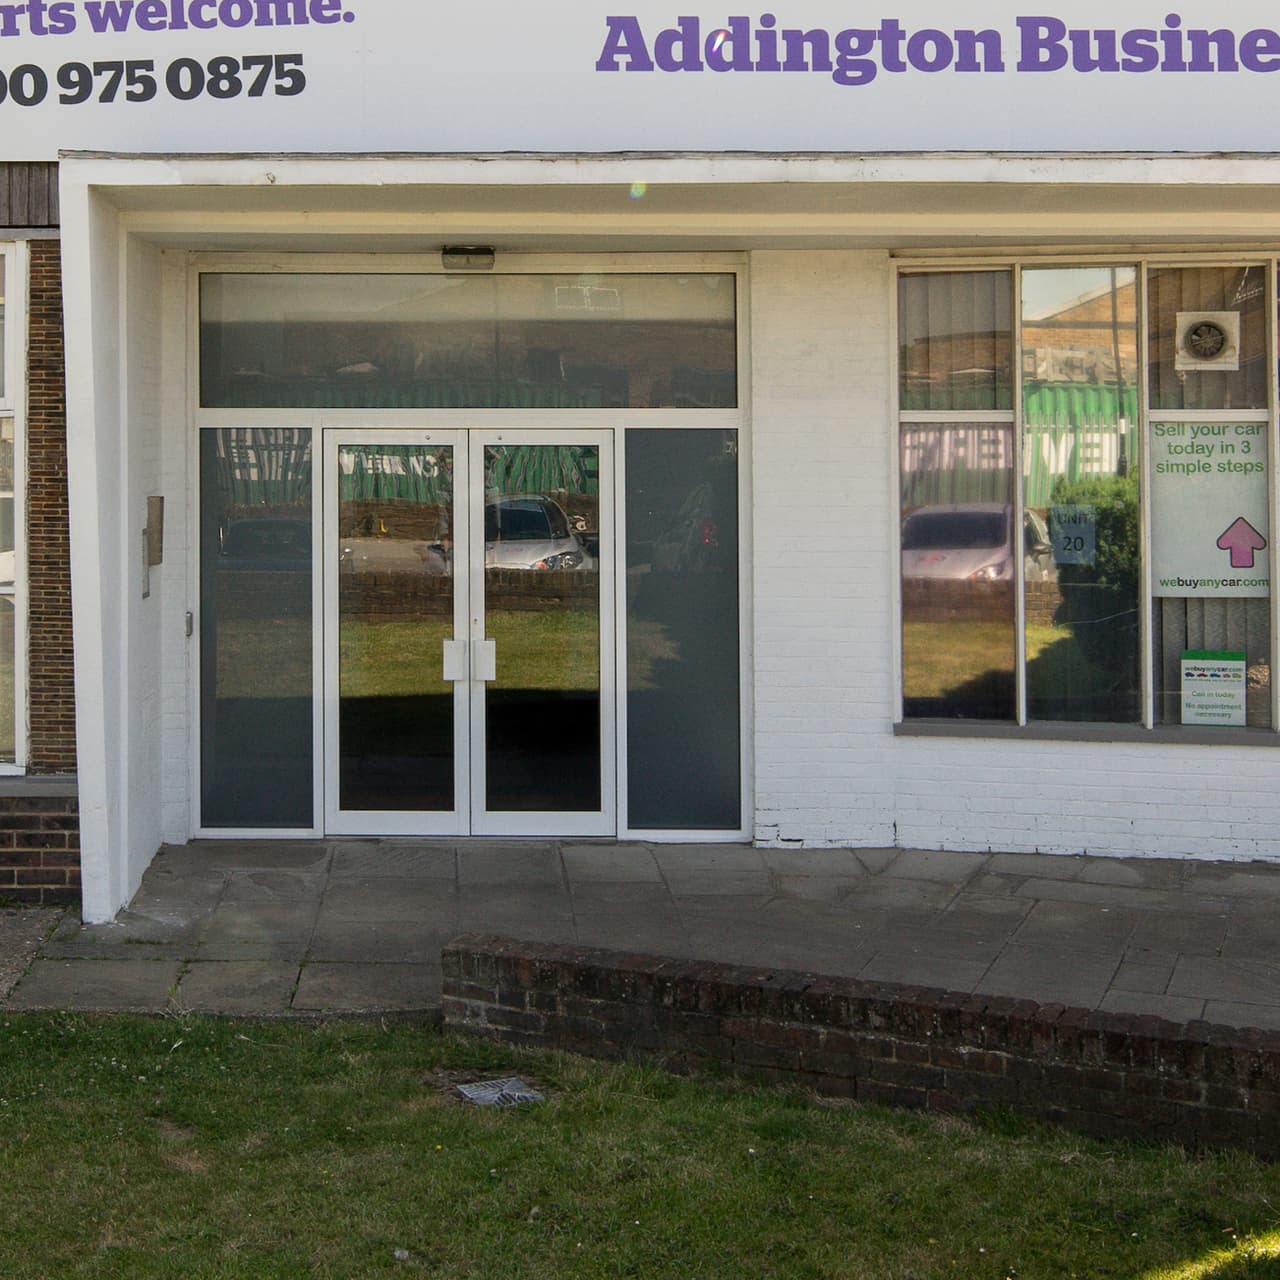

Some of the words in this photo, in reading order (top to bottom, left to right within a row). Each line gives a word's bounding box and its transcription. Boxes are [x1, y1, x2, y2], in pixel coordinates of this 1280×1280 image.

[595, 12, 1005, 86] Addington
[56, 59, 157, 105] 975
[166, 53, 307, 101] 0875
[1154, 424, 1185, 436] Sell
[1190, 424, 1230, 440] your
[1234, 424, 1264, 436] car
[1168, 441, 1215, 457] today
[1220, 440, 1235, 454] in
[1240, 440, 1252, 454] 3
[1156, 460, 1212, 476] simple
[1217, 459, 1264, 474] steps
[1063, 536, 1084, 552] 20
[1160, 576, 1269, 589] webuyanycar.com
